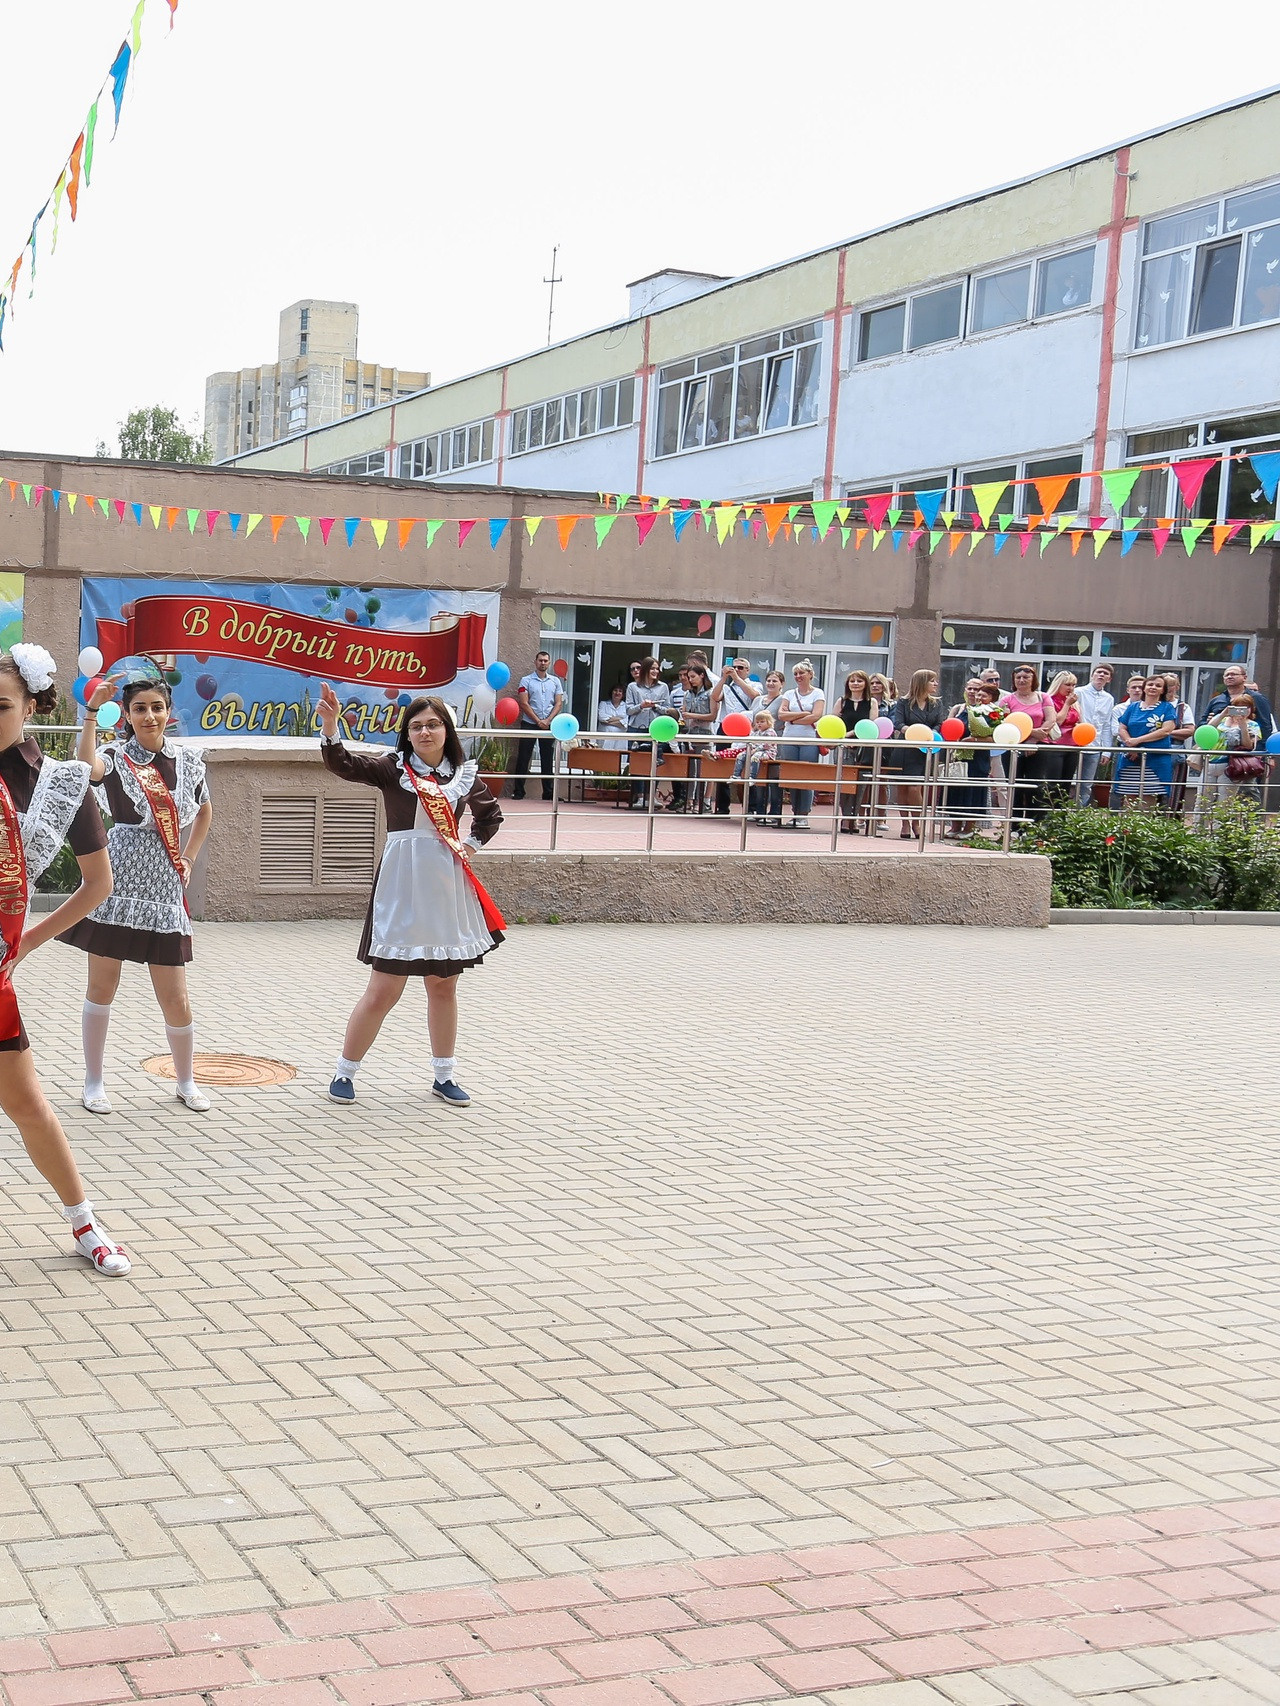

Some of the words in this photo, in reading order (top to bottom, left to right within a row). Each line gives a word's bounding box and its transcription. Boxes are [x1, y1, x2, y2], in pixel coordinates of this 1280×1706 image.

[182, 605, 211, 637] В
[219, 604, 338, 660] добрый
[344, 641, 427, 678] путь,
